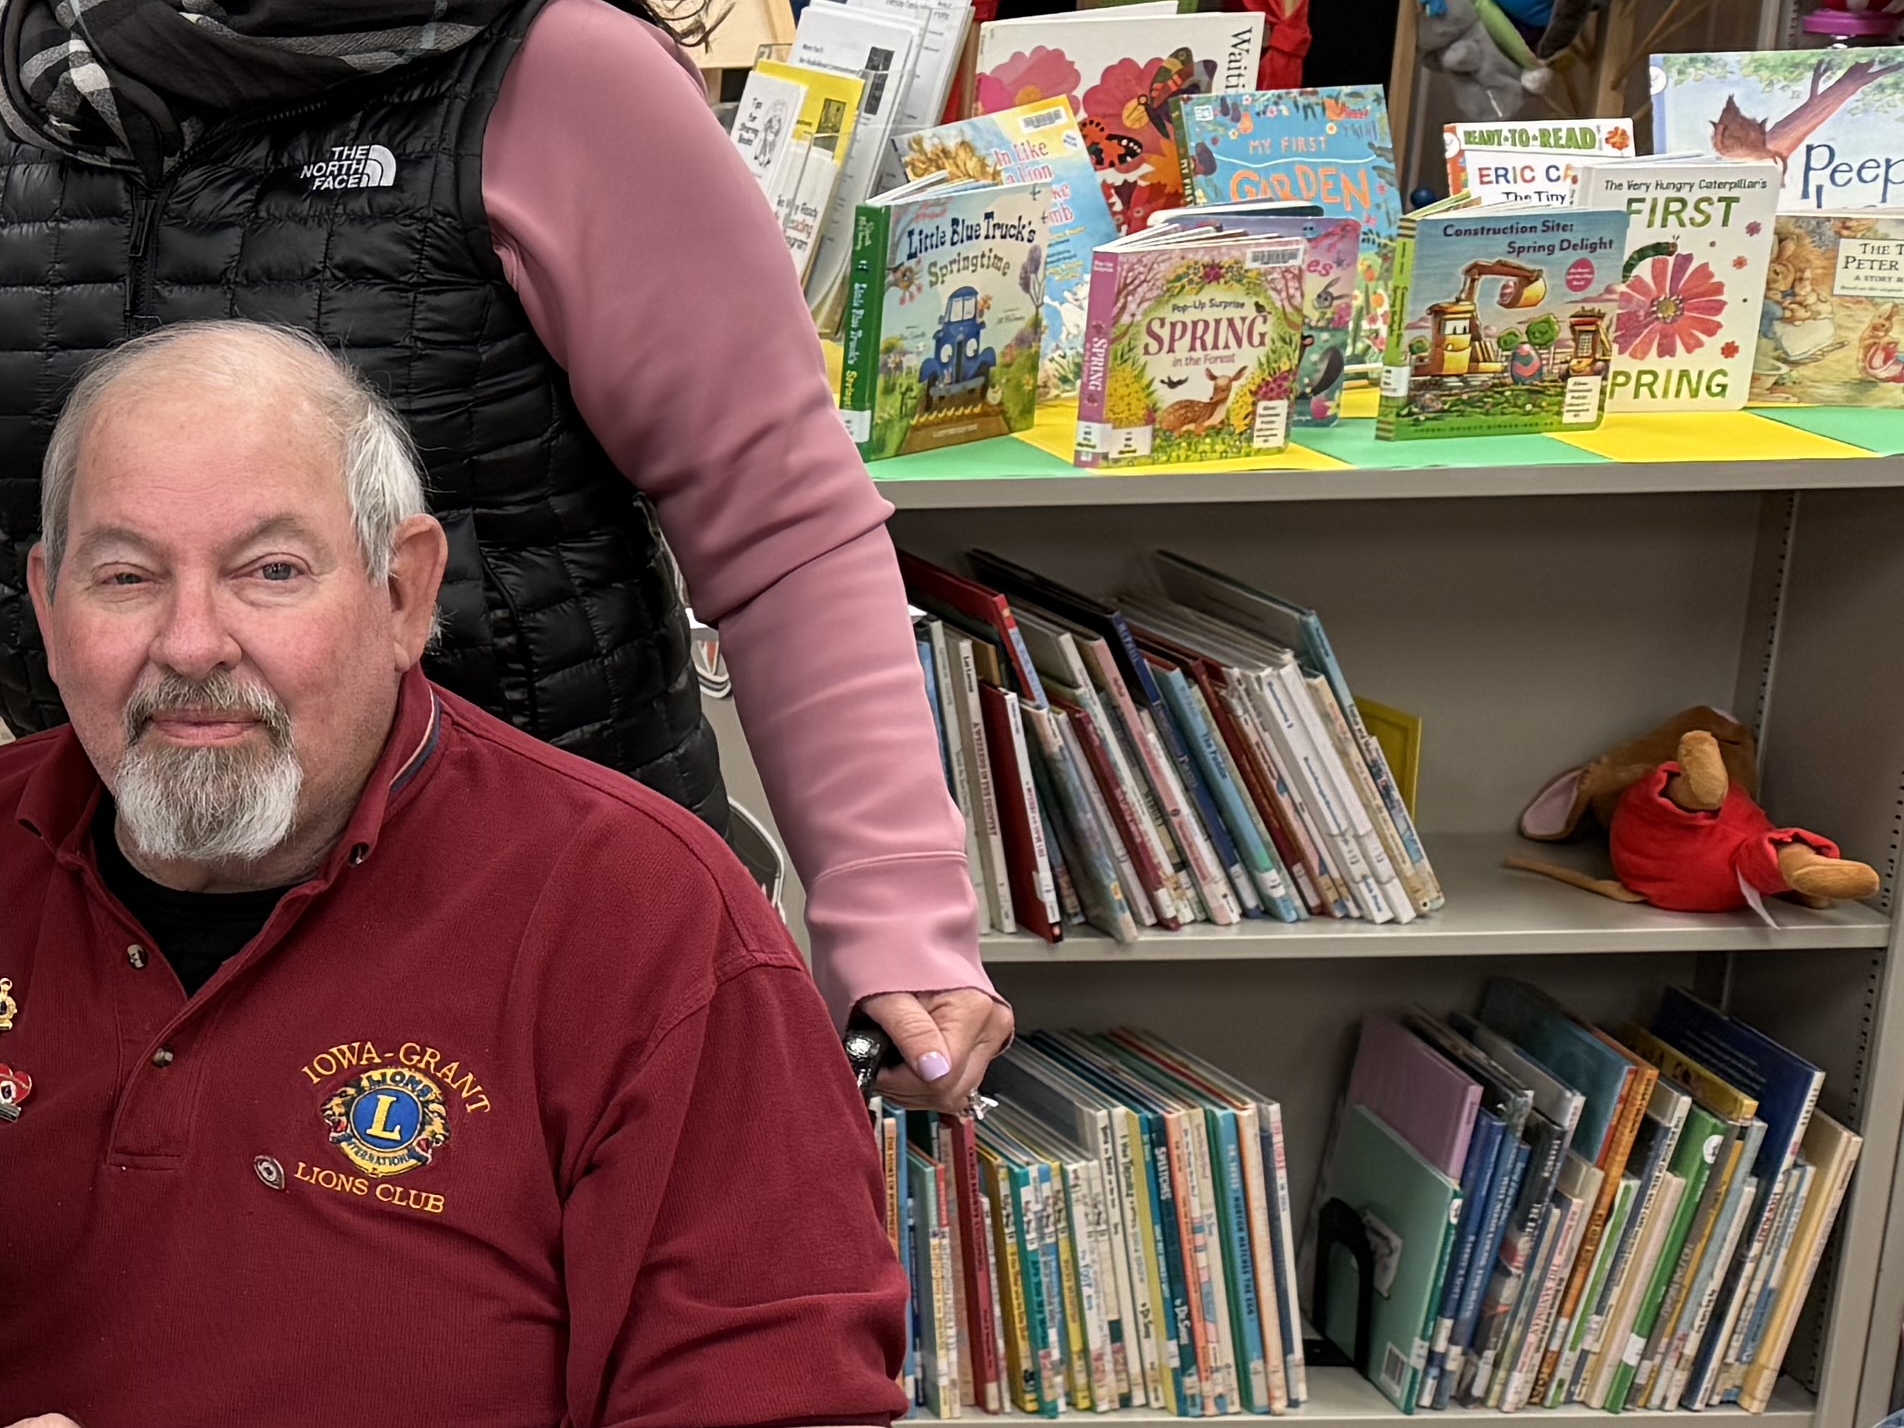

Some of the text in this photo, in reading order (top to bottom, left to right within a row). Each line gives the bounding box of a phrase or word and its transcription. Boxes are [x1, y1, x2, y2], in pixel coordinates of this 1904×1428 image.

[331, 145, 370, 160] THE
[1016, 139, 1050, 161] Like
[1248, 136, 1329, 155] MY FIRST
[300, 160, 365, 179] NORTH
[1478, 165, 1536, 186] ERIC
[312, 175, 361, 190] FACE
[1605, 179, 1767, 193] The Very Hungry Caterpillar's
[1626, 197, 1740, 228] FIRST
[906, 210, 1037, 261] Little Blue Truck's
[1443, 220, 1574, 237] Construction Site:
[1507, 238, 1613, 257] Spring Delight
[1859, 243, 1890, 255] THE
[927, 249, 1011, 289] Springtime
[1843, 256, 1899, 270] PETER
[1864, 274, 1893, 283] STORY
[1171, 297, 1246, 313] Pop-Up Surprise
[1142, 313, 1271, 357] SPRING
[1088, 336, 1108, 393] SPRING
[1203, 351, 1236, 364] Forest
[301, 1041, 491, 1113] IOWA-GRANT
[368, 1071, 432, 1100] LIONS
[366, 1094, 401, 1141] L
[294, 1161, 445, 1213] LIONS CLUB
